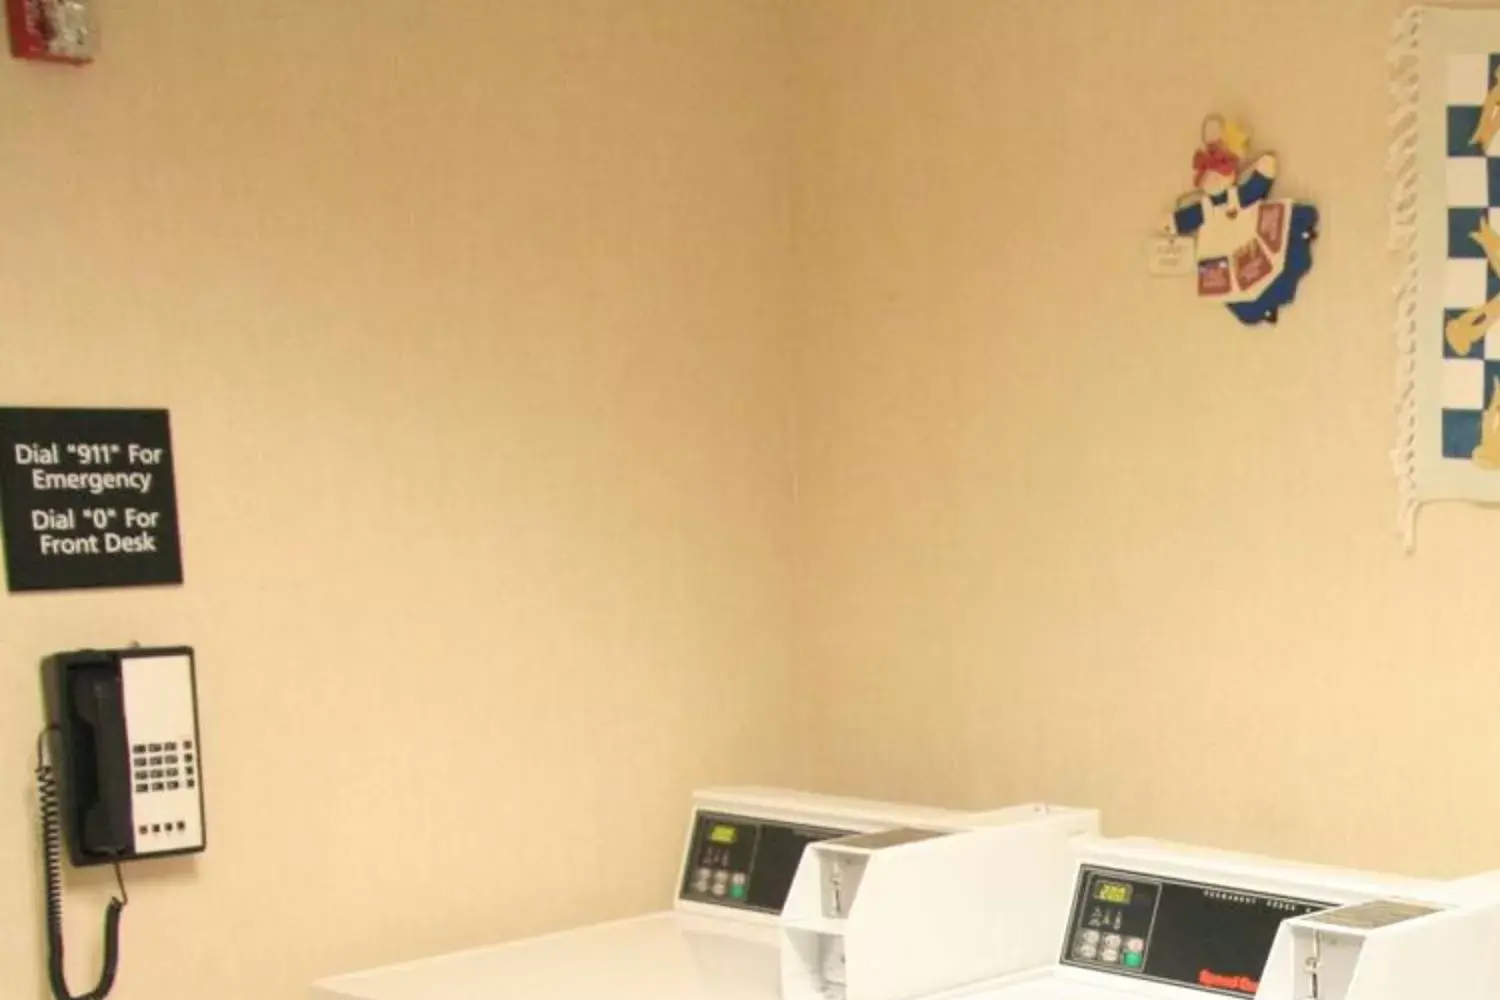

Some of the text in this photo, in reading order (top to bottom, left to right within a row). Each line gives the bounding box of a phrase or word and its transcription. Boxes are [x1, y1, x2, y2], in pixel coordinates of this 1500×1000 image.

[14, 442, 163, 465] Dial "911" For
[31, 468, 152, 494] Emergency
[31, 507, 160, 531] Dial "0" For
[39, 531, 157, 555] Front Desk
